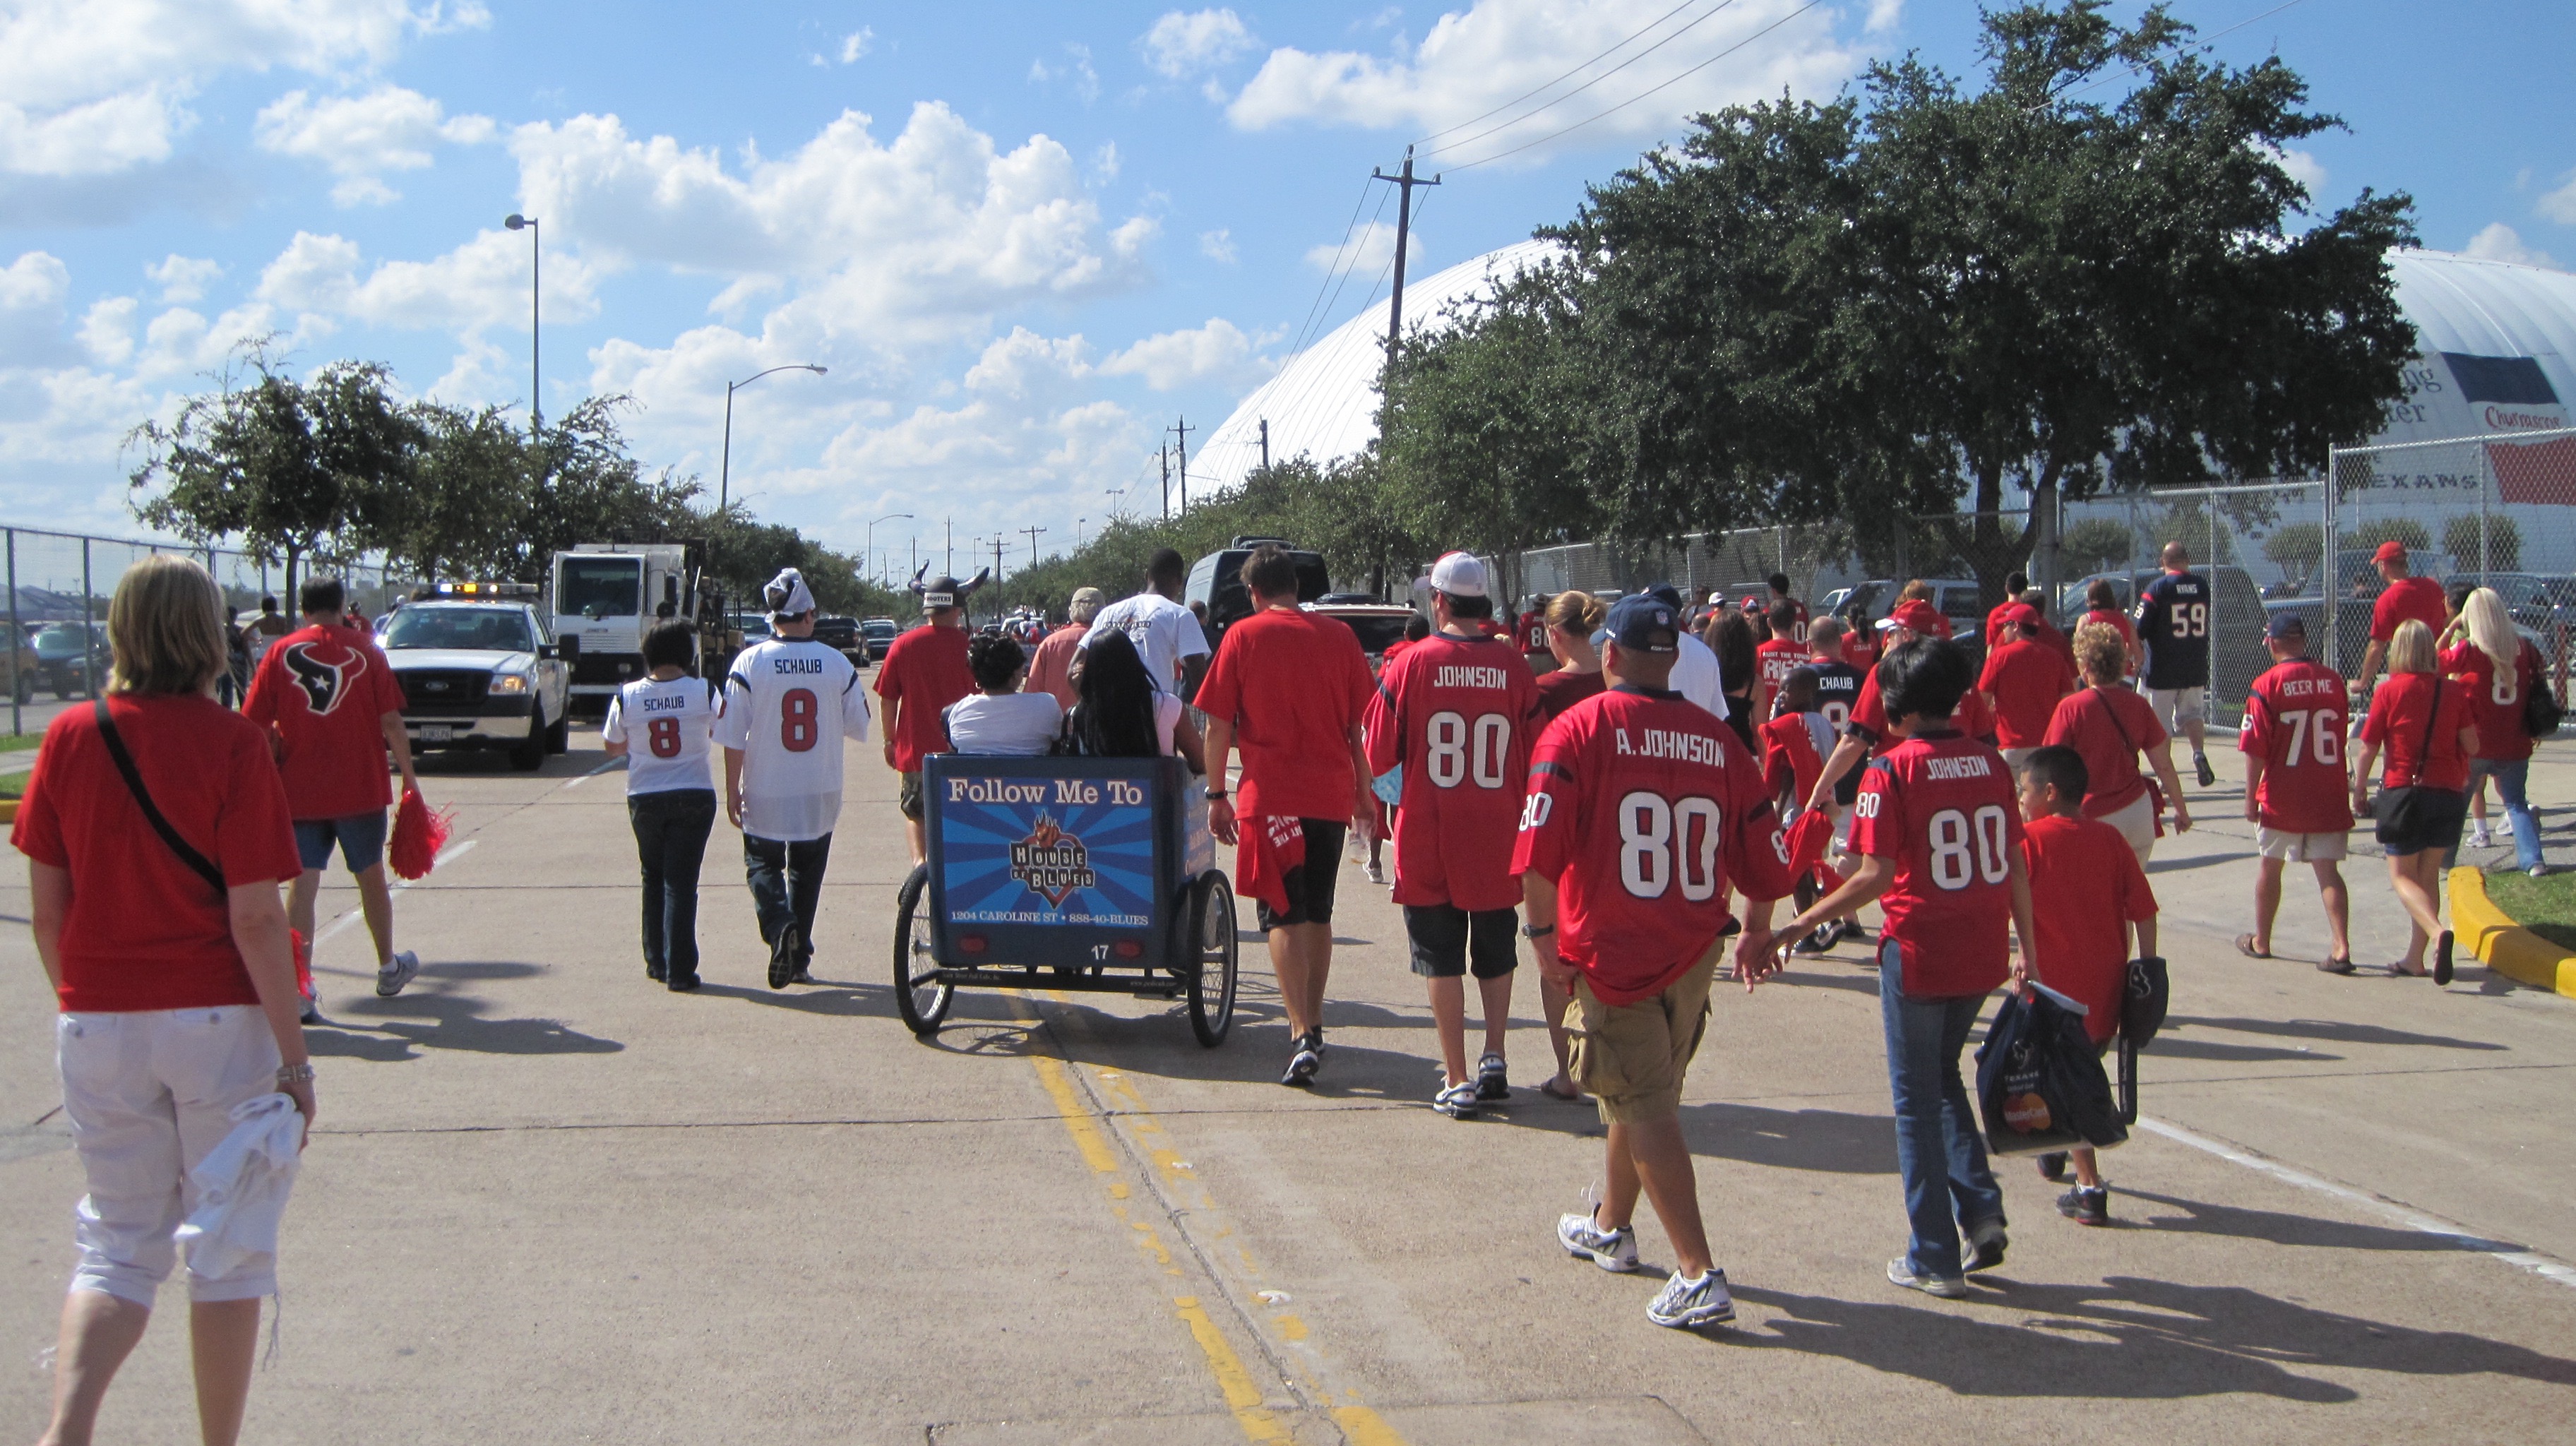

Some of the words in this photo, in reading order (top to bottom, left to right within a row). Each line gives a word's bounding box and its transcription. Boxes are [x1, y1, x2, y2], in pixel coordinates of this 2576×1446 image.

[2371, 474, 2478, 489] EXANS
[2171, 602, 2206, 638] 59
[1794, 621, 1806, 645] 0
[775, 659, 822, 674] SCHAUB
[1434, 666, 1506, 690] JOHNSON
[1818, 676, 1854, 691] CHAUB
[2283, 680, 2313, 697] BEER
[2317, 679, 2333, 694] ME
[644, 695, 684, 711] SCHAUB
[781, 688, 818, 753] 8
[2241, 713, 2253, 731] 6
[648, 717, 681, 758] 8
[1616, 728, 1636, 755] A.
[1640, 728, 1725, 769] JOHNSON
[2279, 708, 2339, 767] 76
[1427, 712, 1510, 788] 80
[1926, 755, 1991, 780] JOHNSON
[948, 778, 1045, 803] Follow
[1055, 779, 1099, 804] Me
[1107, 780, 1143, 805] To
[1855, 791, 1880, 818] 80
[1017, 847, 1083, 864] HOUSE
[1619, 791, 1721, 901] 80
[1929, 805, 2009, 890] 80
[1032, 873, 1092, 888] BLUES
[953, 912, 977, 921] 1204
[979, 912, 1040, 922] CAROLINE
[1043, 913, 1059, 922] ST
[1069, 914, 1149, 926] 888-40-BLUES
[1091, 945, 1109, 960] 17
[2005, 1106, 2047, 1121] MasterCard
